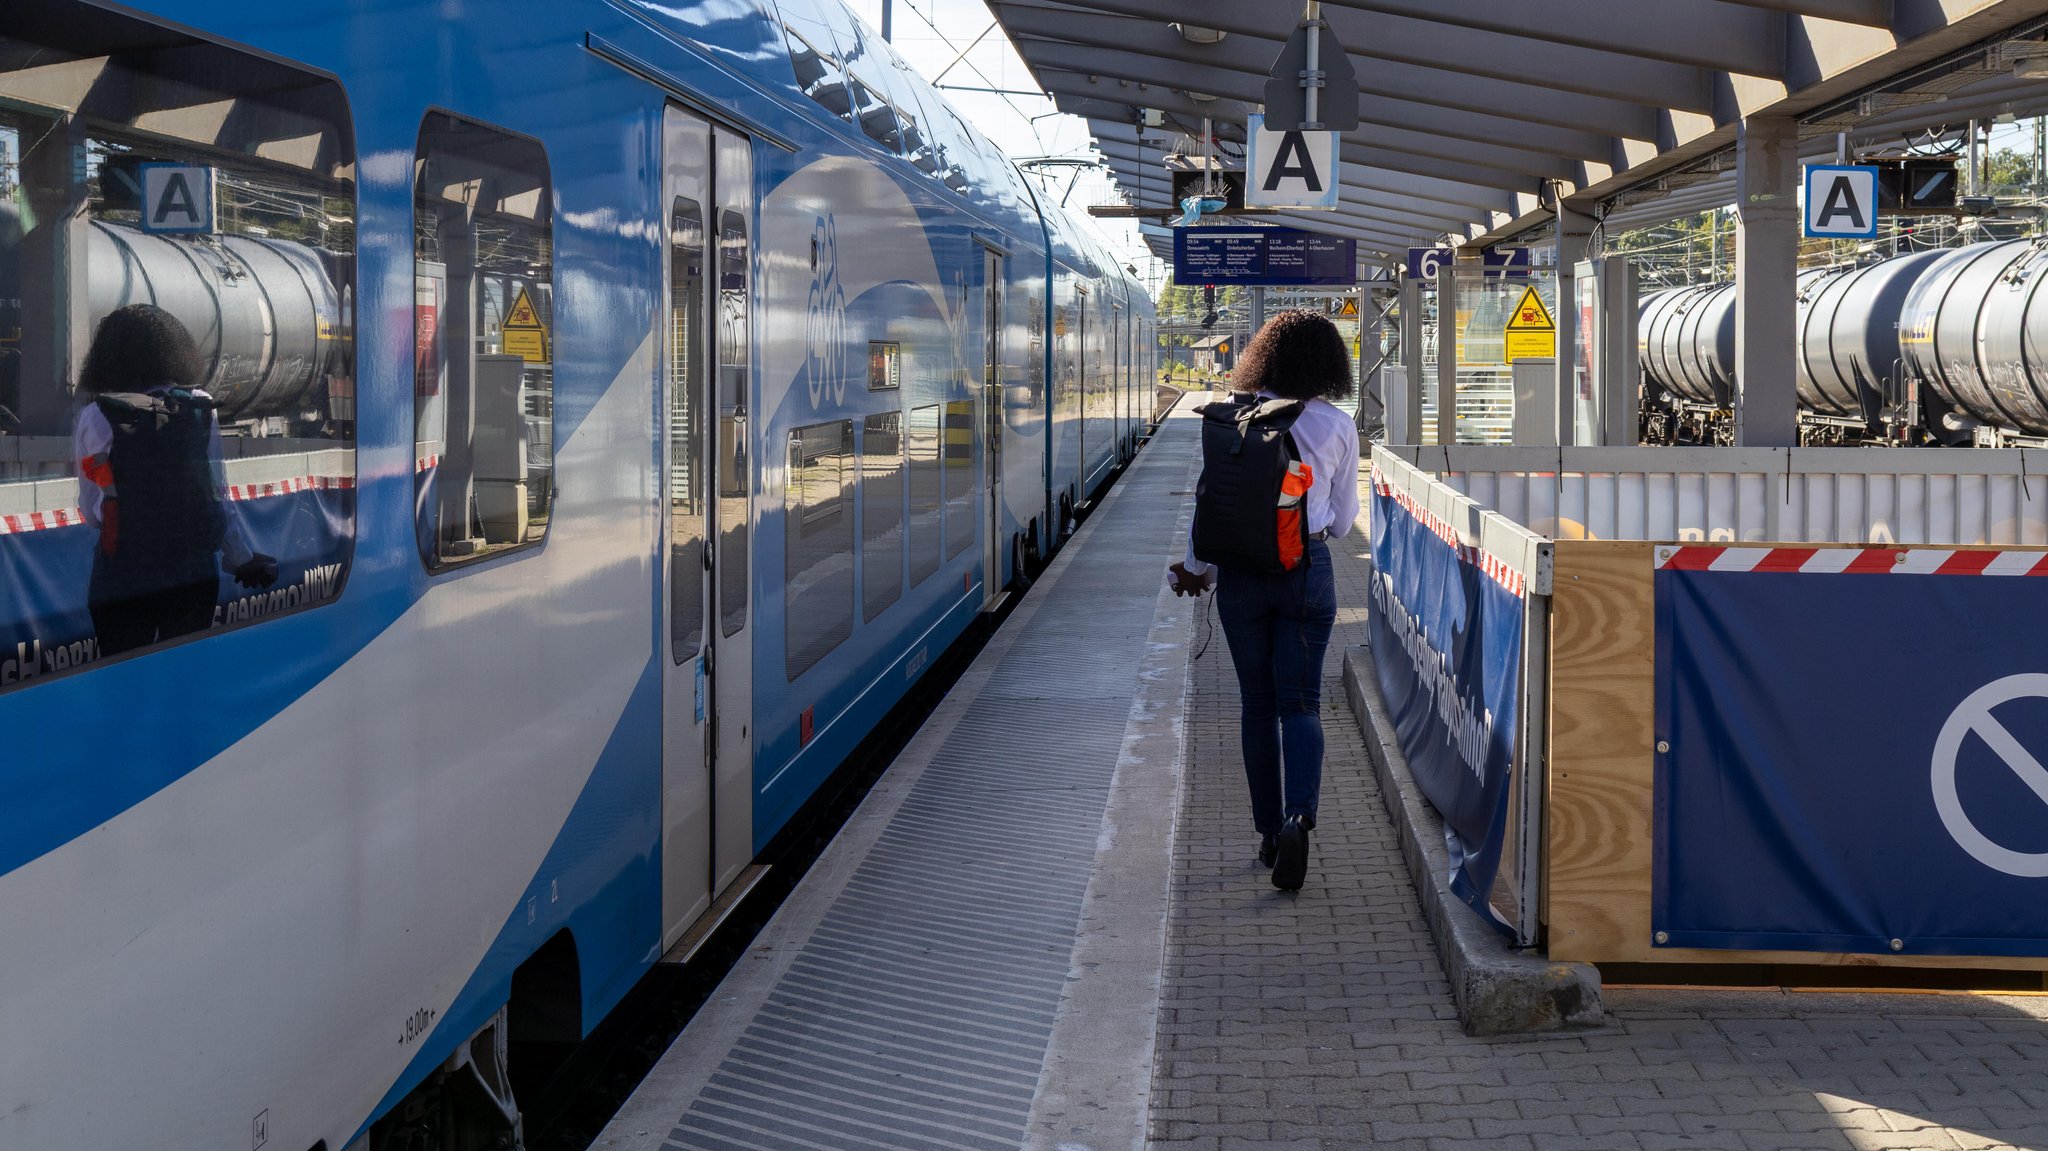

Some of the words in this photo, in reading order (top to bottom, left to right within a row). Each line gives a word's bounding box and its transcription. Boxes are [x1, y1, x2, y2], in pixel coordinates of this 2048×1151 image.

[1262, 130, 1323, 191] A
[1815, 175, 1866, 228] A
[1420, 249, 1440, 280] 6
[1496, 249, 1516, 280] 7
